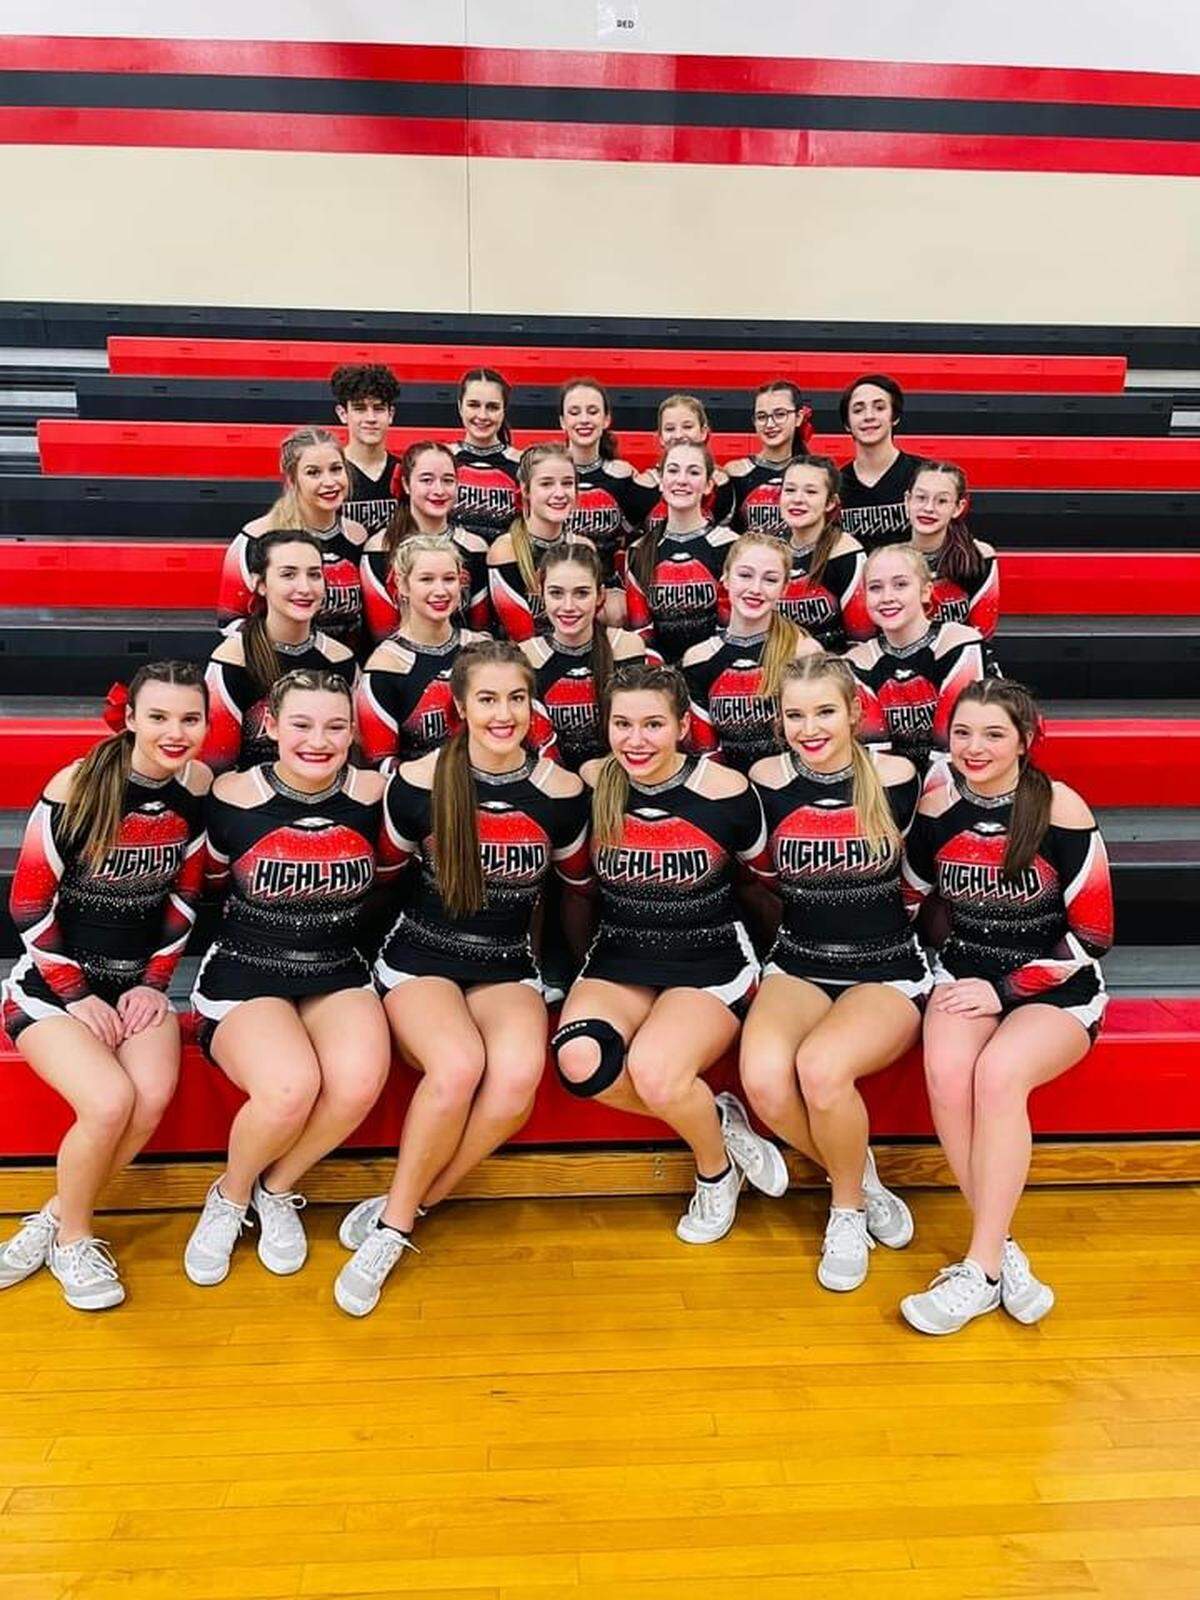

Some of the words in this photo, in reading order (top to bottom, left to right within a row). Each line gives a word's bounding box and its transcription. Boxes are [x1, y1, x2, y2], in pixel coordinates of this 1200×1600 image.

[251, 855, 374, 898] HIGHLAND
[595, 844, 711, 884] HIGHLAND
[939, 860, 1043, 902] HIGHLAND
